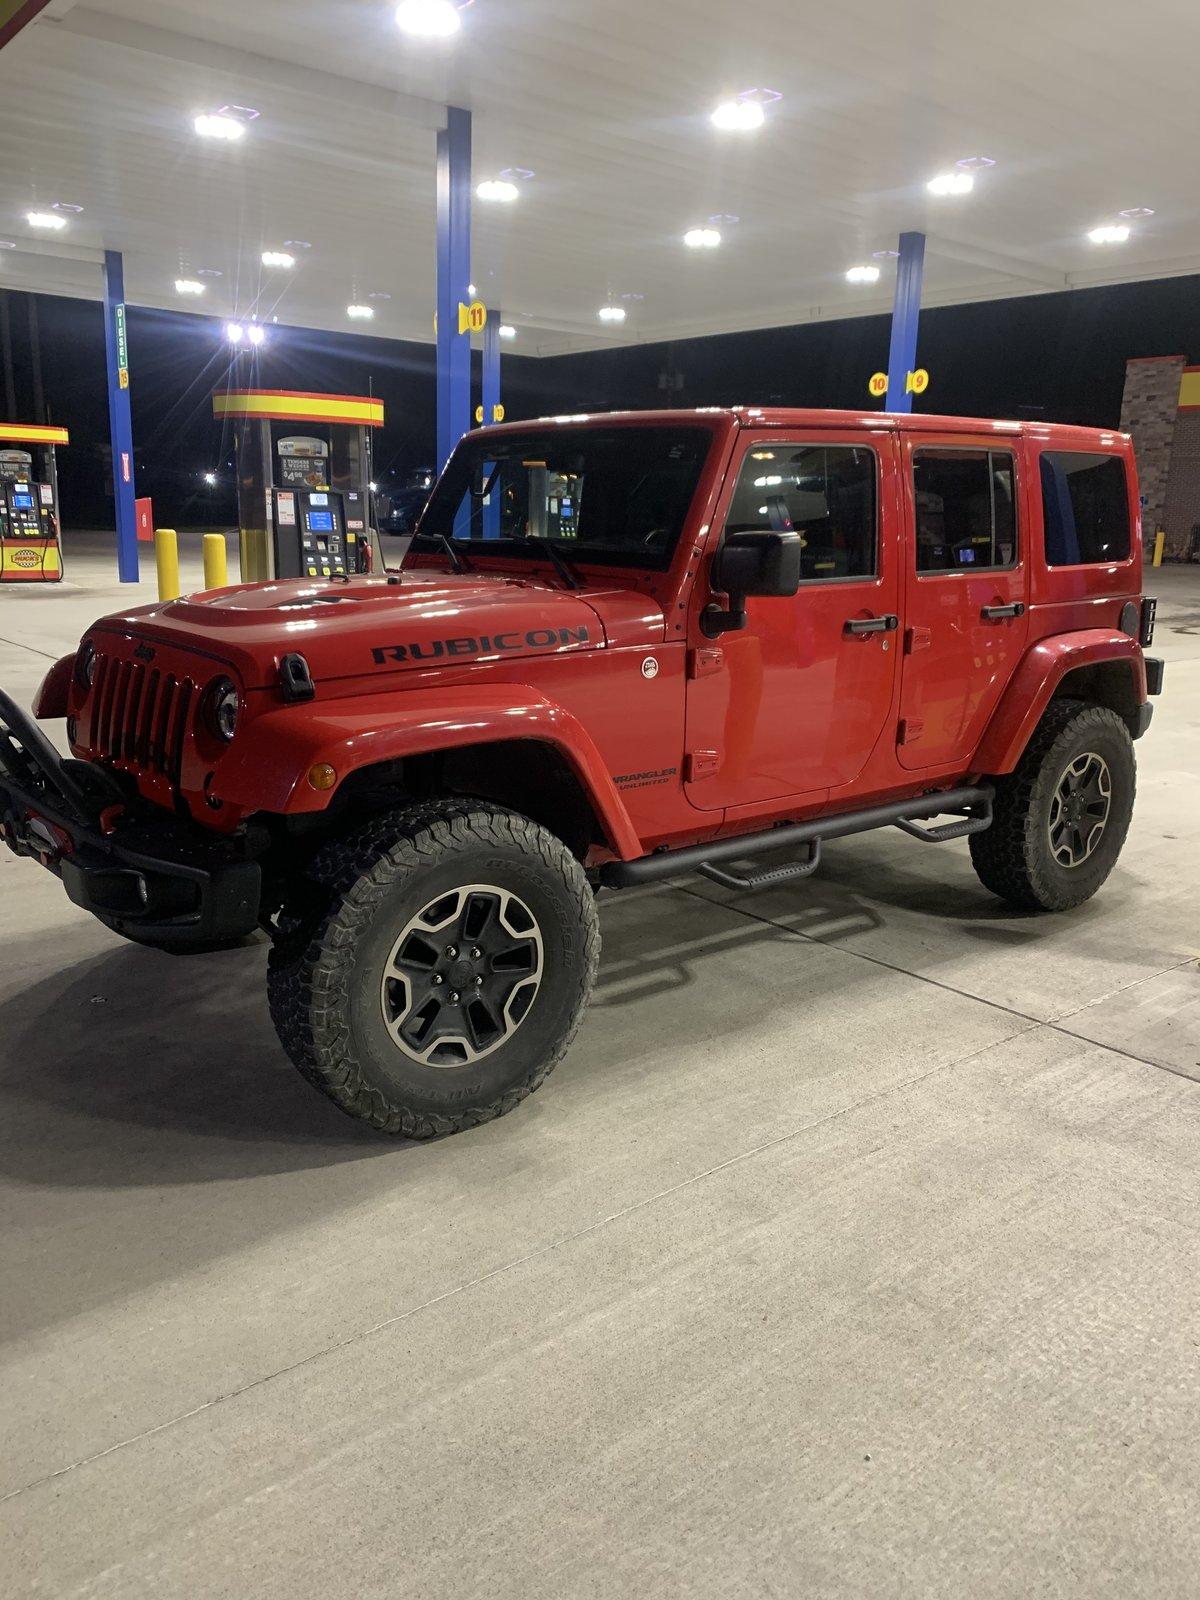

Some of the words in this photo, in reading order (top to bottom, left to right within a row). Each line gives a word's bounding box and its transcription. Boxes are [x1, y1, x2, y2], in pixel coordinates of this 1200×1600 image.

[471, 308, 483, 326] 11
[117, 308, 125, 365] DIESEL
[873, 378, 885, 390] 10
[917, 375, 923, 388] 9
[371, 625, 589, 664] RUBICON
[619, 778, 669, 790] UNLIMITED
